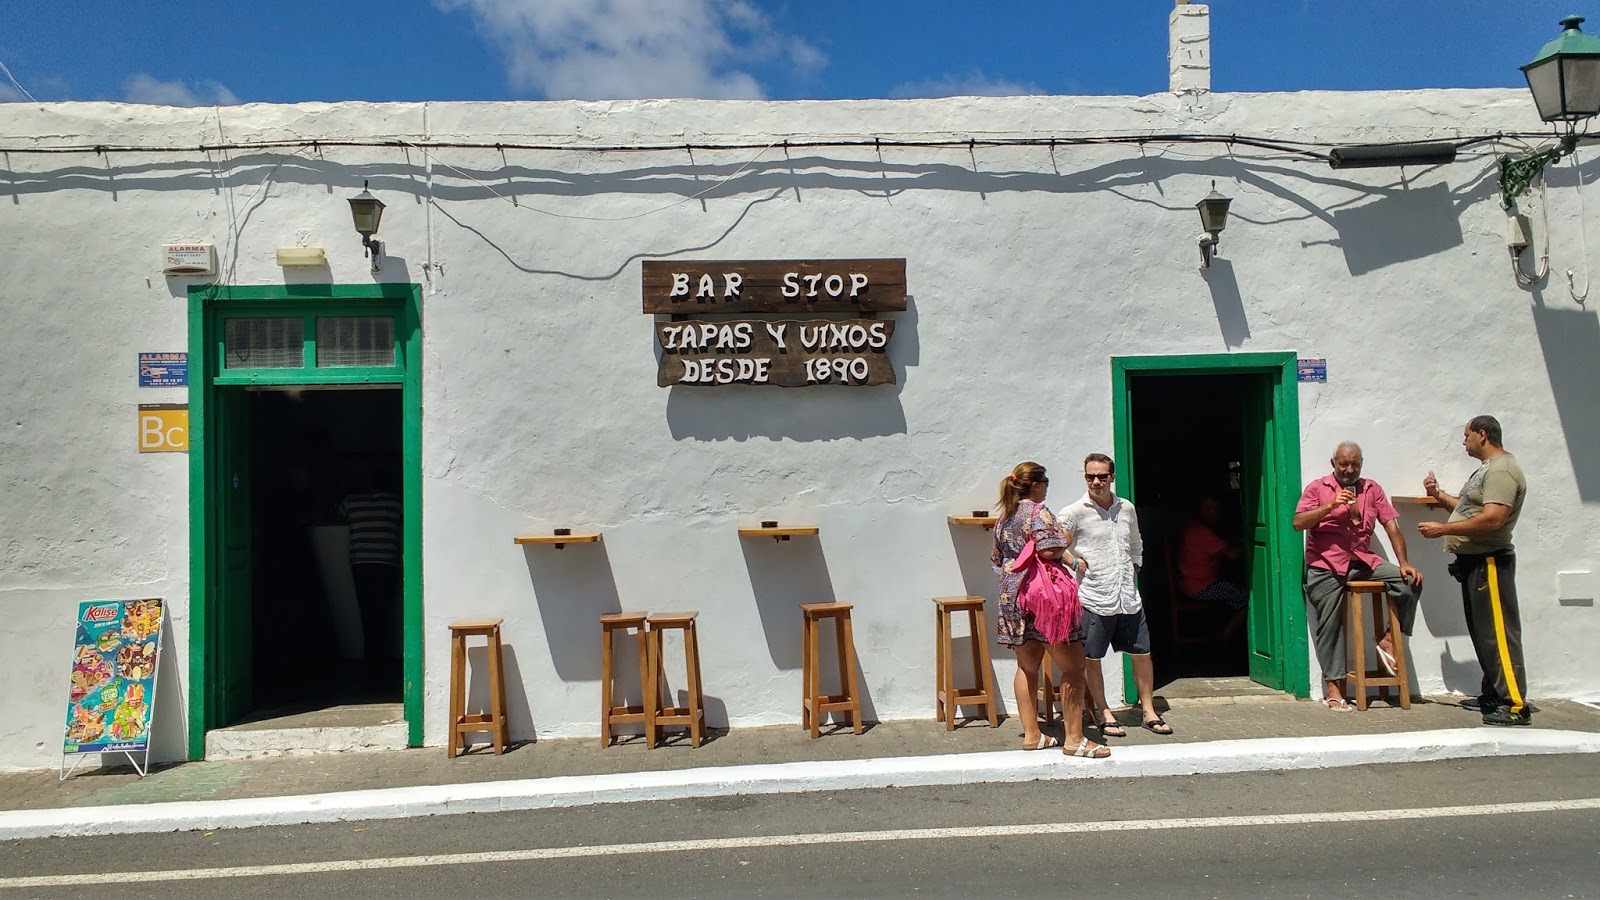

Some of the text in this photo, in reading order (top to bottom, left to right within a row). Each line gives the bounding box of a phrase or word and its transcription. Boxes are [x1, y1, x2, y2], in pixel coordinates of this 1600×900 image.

[670, 273, 868, 298] BAR STOP
[663, 322, 754, 349] TAPAS
[766, 323, 787, 349] Y
[140, 353, 187, 361] ALARMA
[679, 357, 869, 383] DESDE 1890
[142, 415, 184, 448] Bc
[85, 604, 118, 622] Kalise
